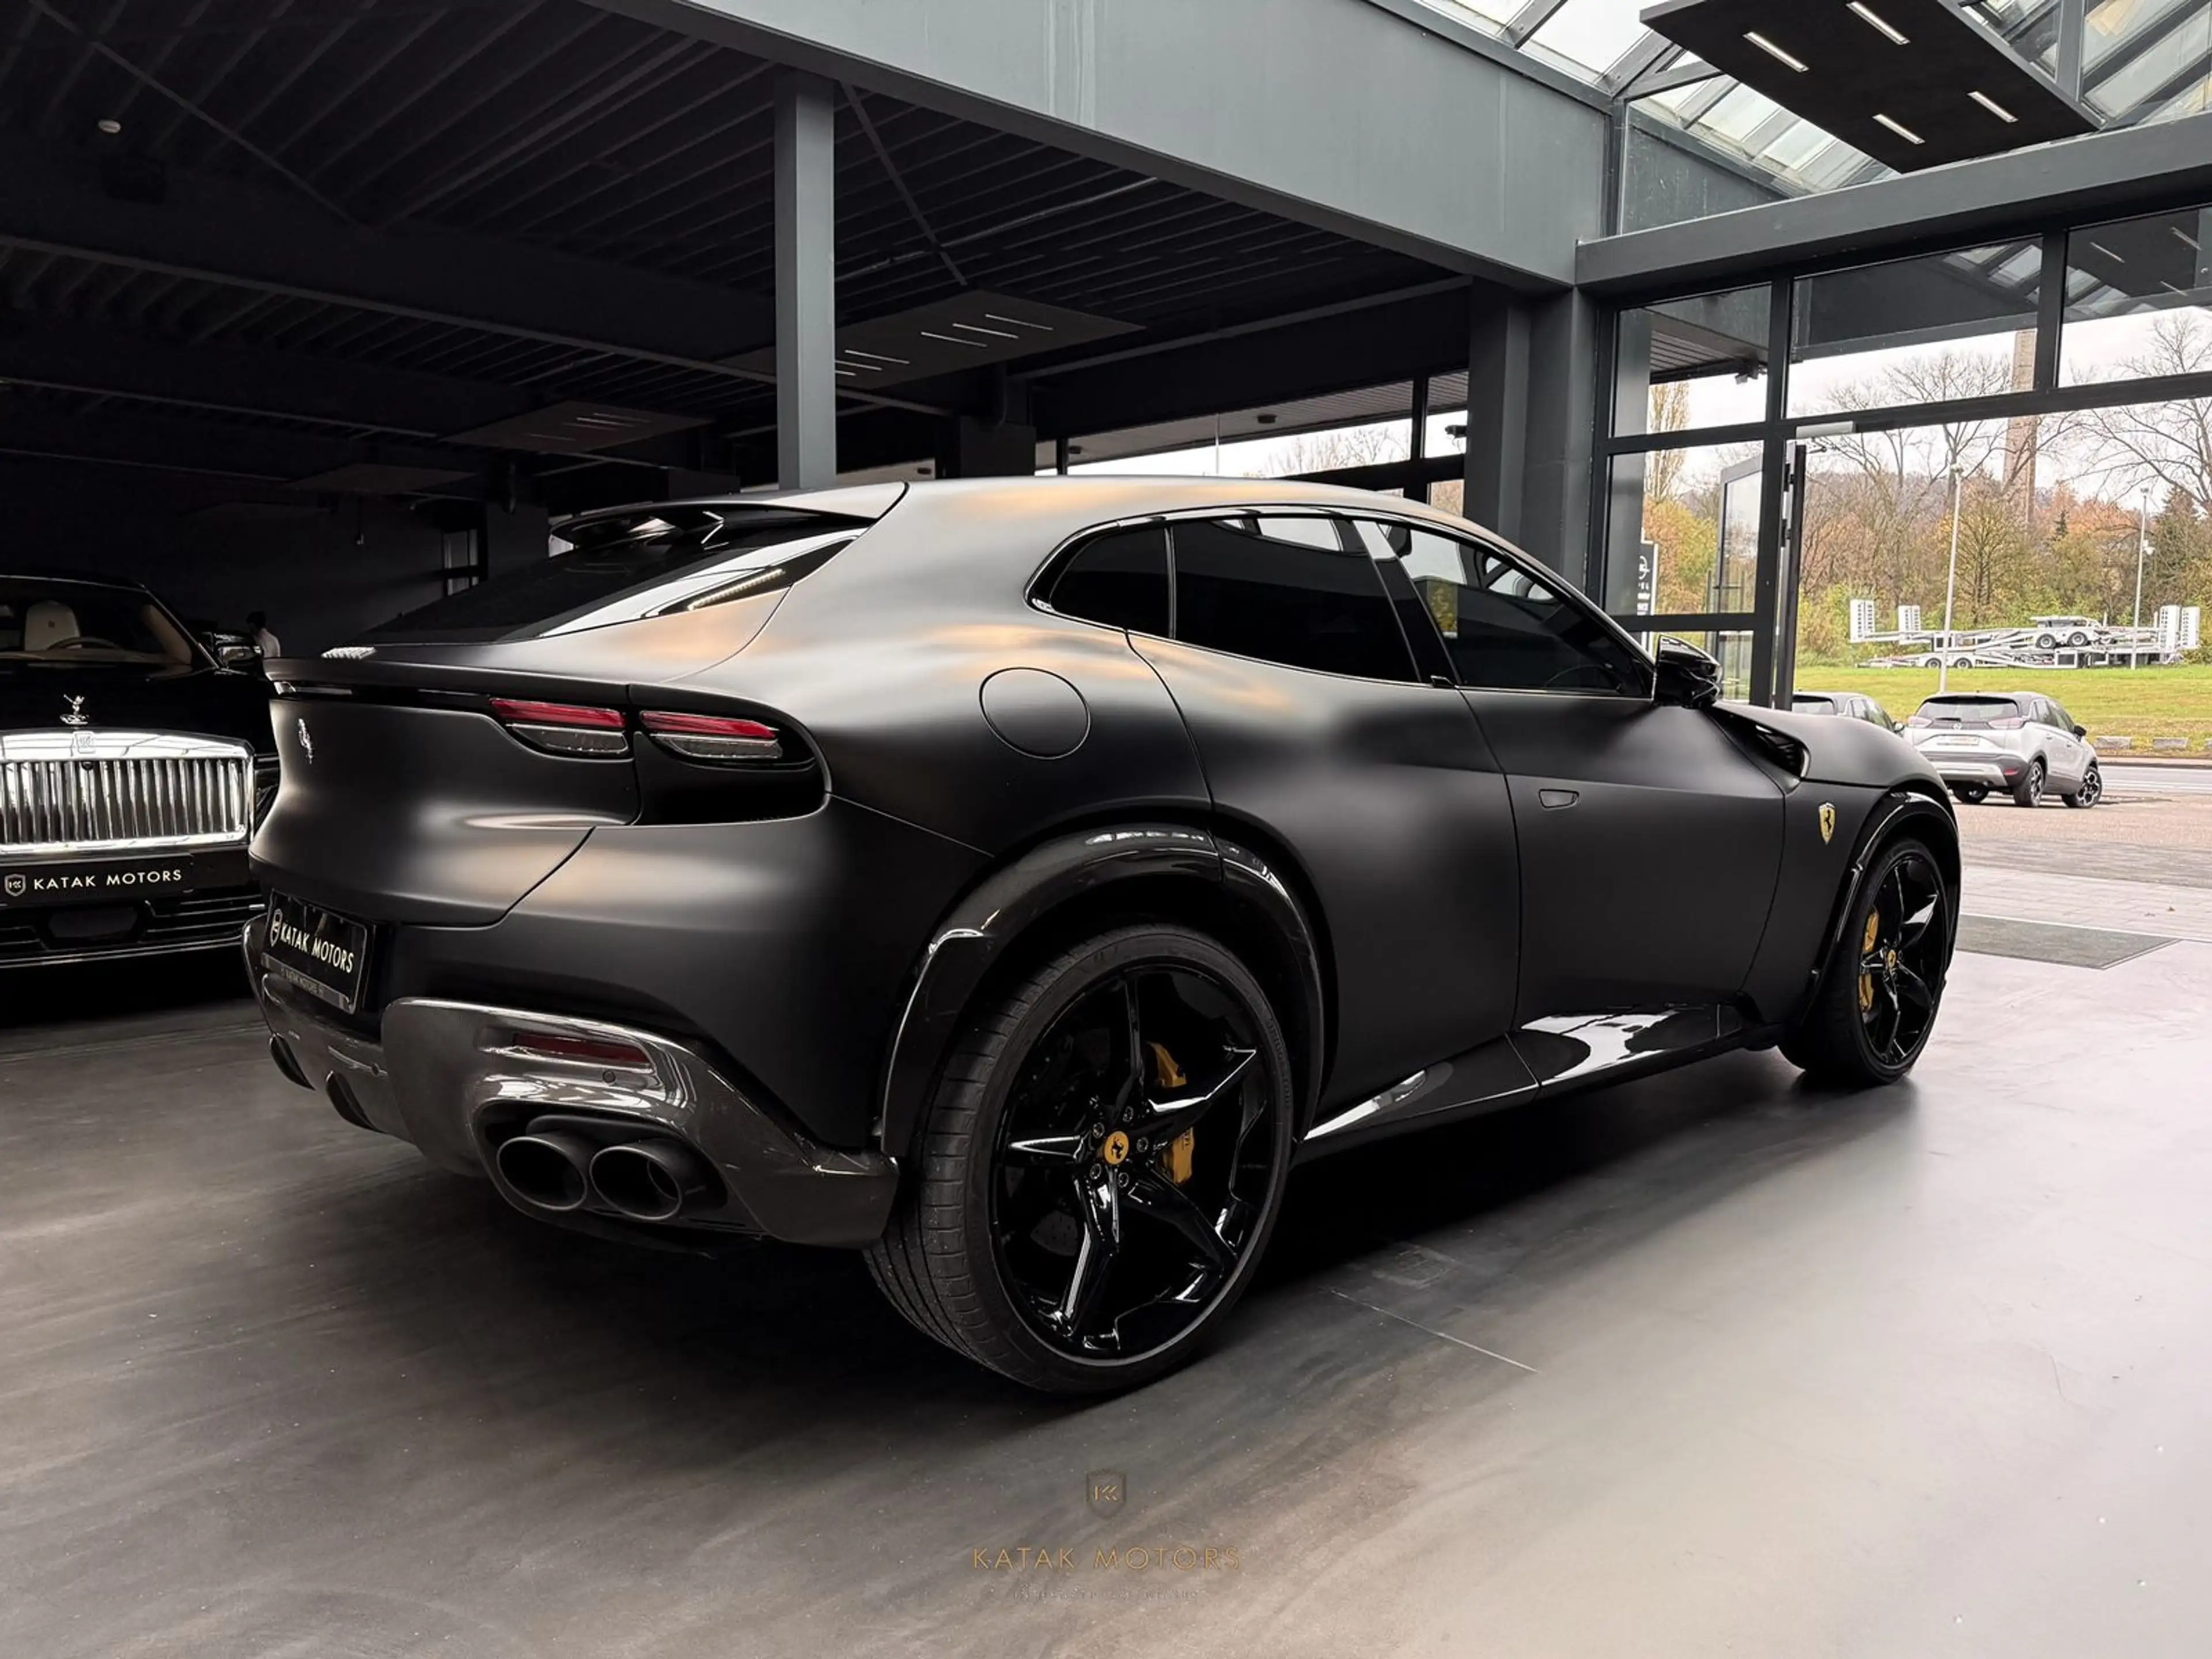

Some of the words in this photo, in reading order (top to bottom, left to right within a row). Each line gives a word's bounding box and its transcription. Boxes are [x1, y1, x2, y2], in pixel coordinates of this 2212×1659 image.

[33, 875, 96, 890] KATAK
[106, 869, 182, 886] MOTORS
[280, 922, 310, 953] KATAK
[311, 937, 354, 973] MOTORS
